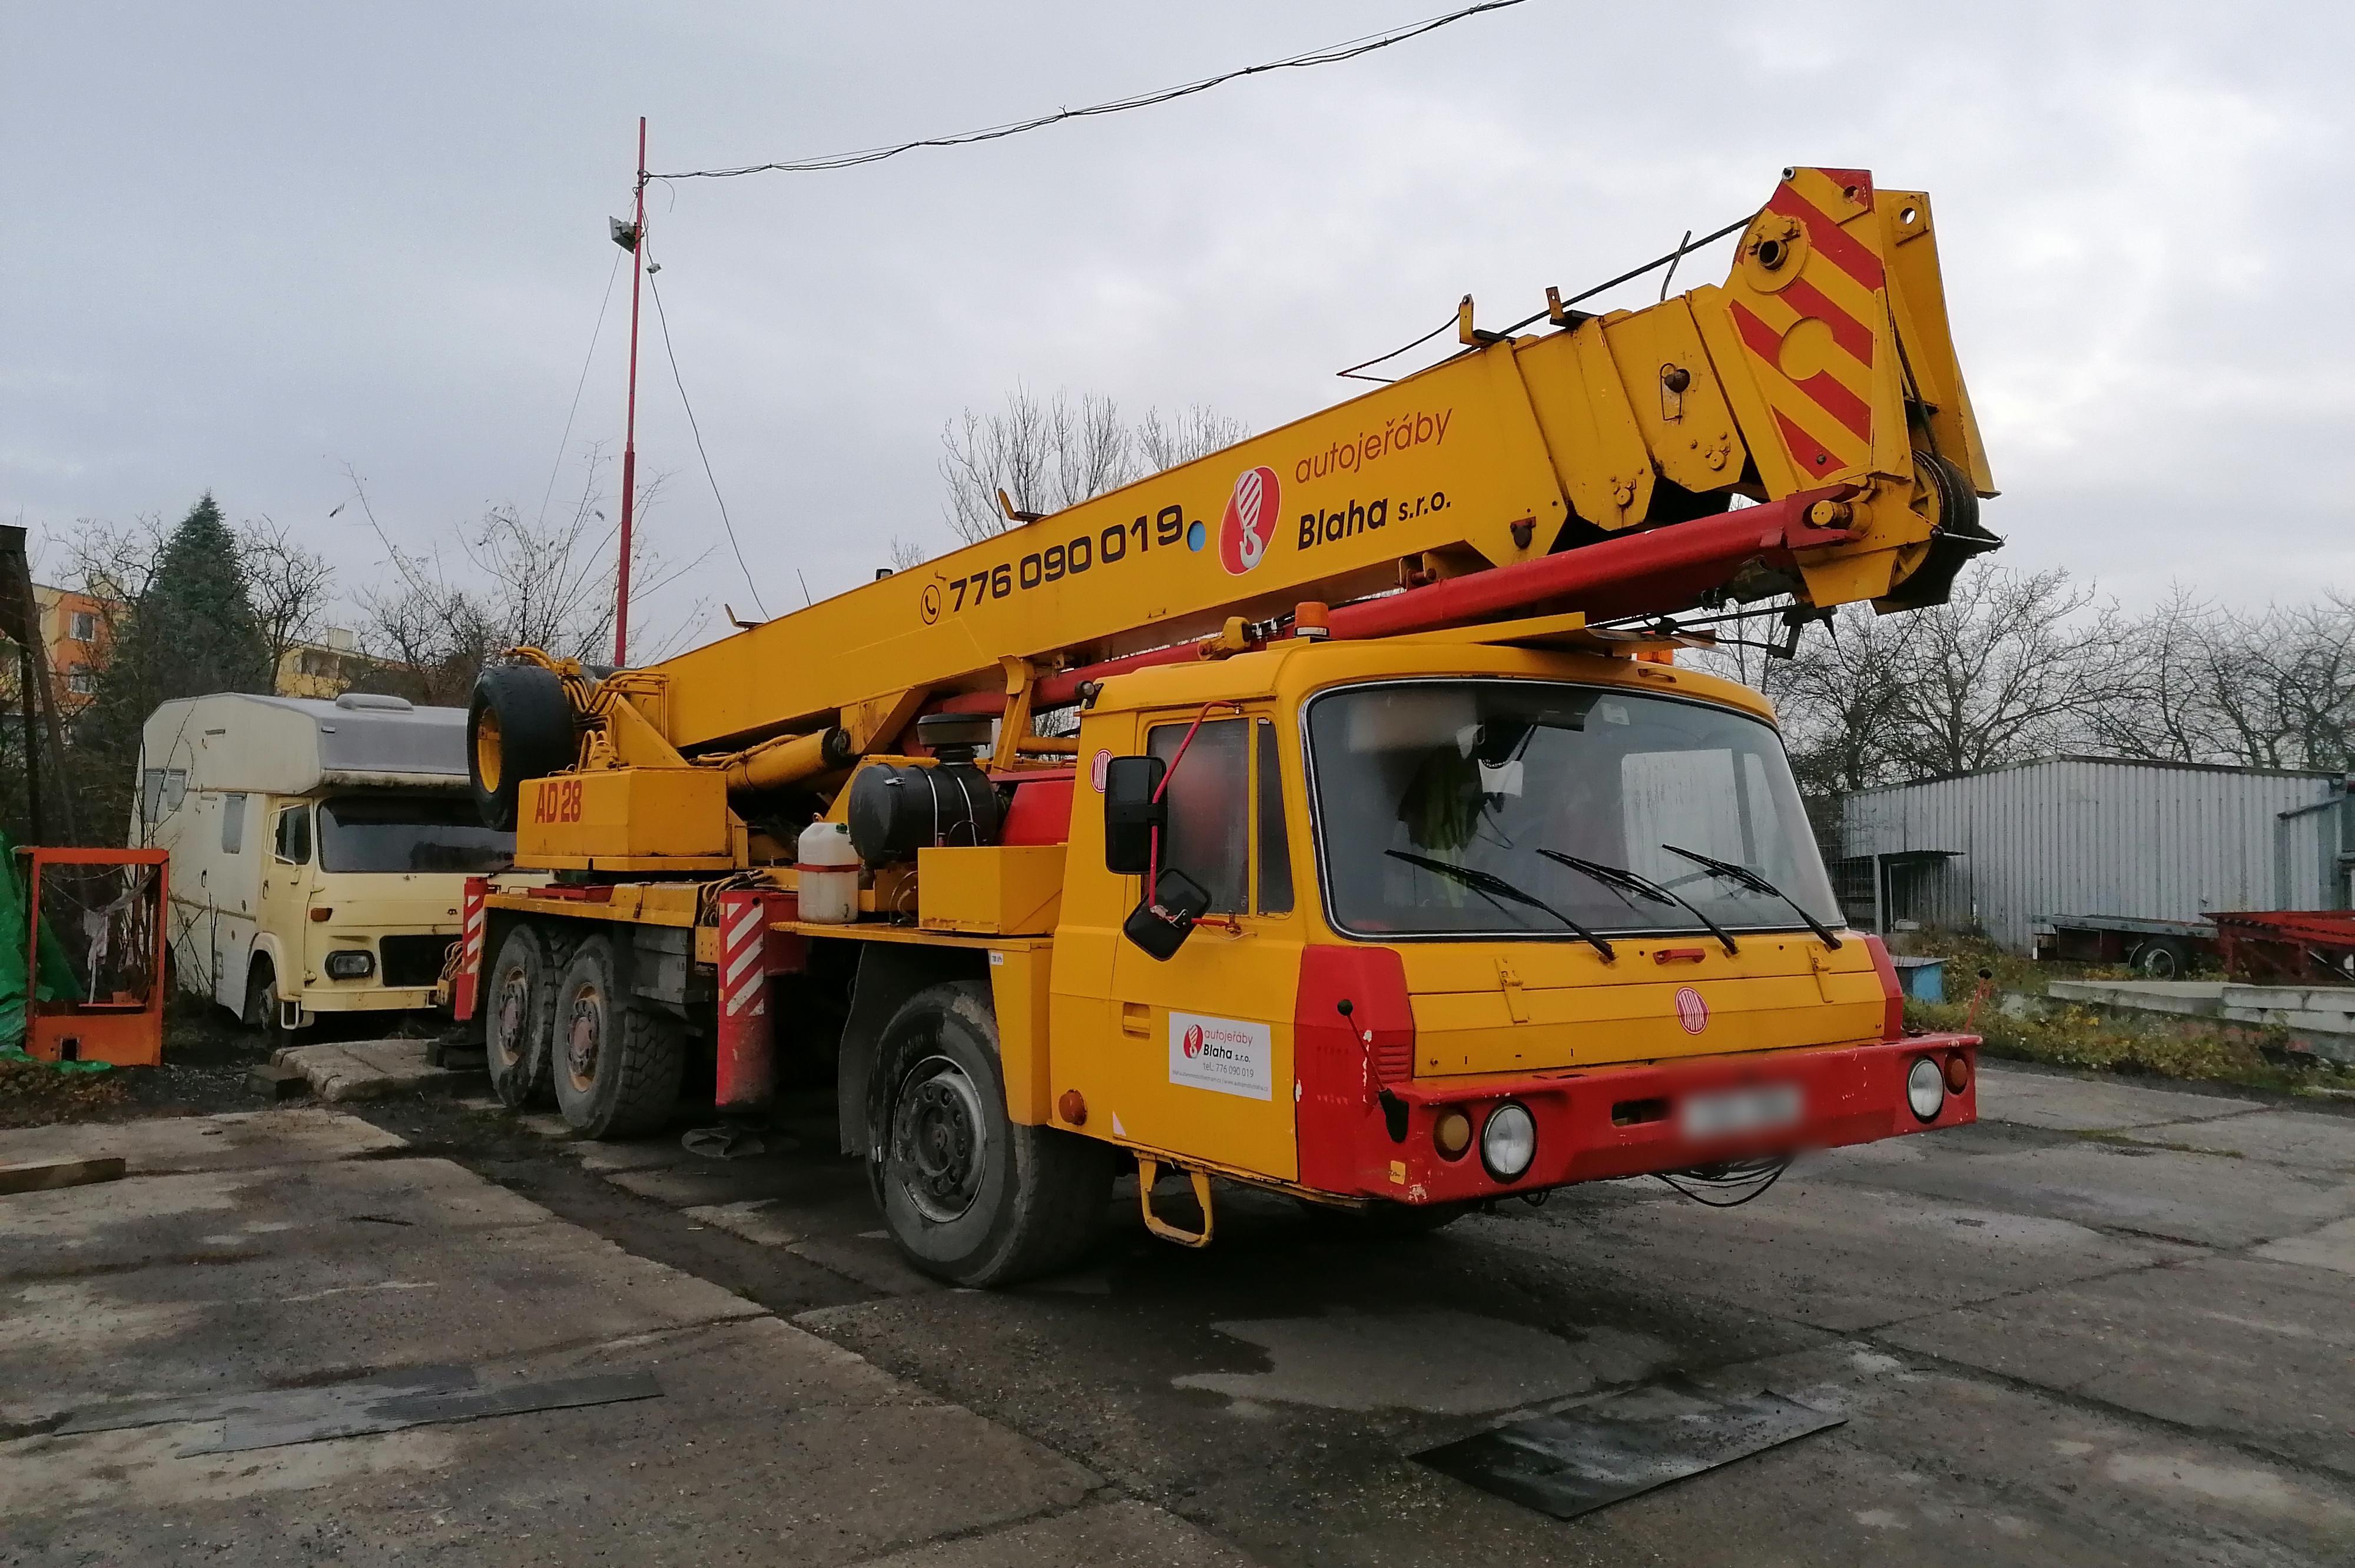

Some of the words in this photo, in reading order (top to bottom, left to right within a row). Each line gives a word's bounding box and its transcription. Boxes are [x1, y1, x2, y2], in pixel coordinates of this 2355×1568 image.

[1295, 408, 1452, 484] autojeřáby
[1298, 497, 1388, 551] Blaha
[1398, 491, 1451, 521] s.r.o.
[949, 563, 1011, 613] 776
[1020, 535, 1092, 590] 090
[1100, 504, 1183, 564] 019
[1094, 752, 1111, 790] TATR
[535, 782, 558, 824] AD
[560, 780, 582, 823] 28
[1678, 990, 1705, 1032] TATRA
[1203, 1043, 1232, 1059] Blaha
[1235, 1054, 1251, 1063] s.r.o.
[1205, 1029, 1253, 1047] autojeřáby
[1216, 1063, 1228, 1073] 776
[1228, 1065, 1240, 1076] 090
[1242, 1068, 1254, 1078] 019
